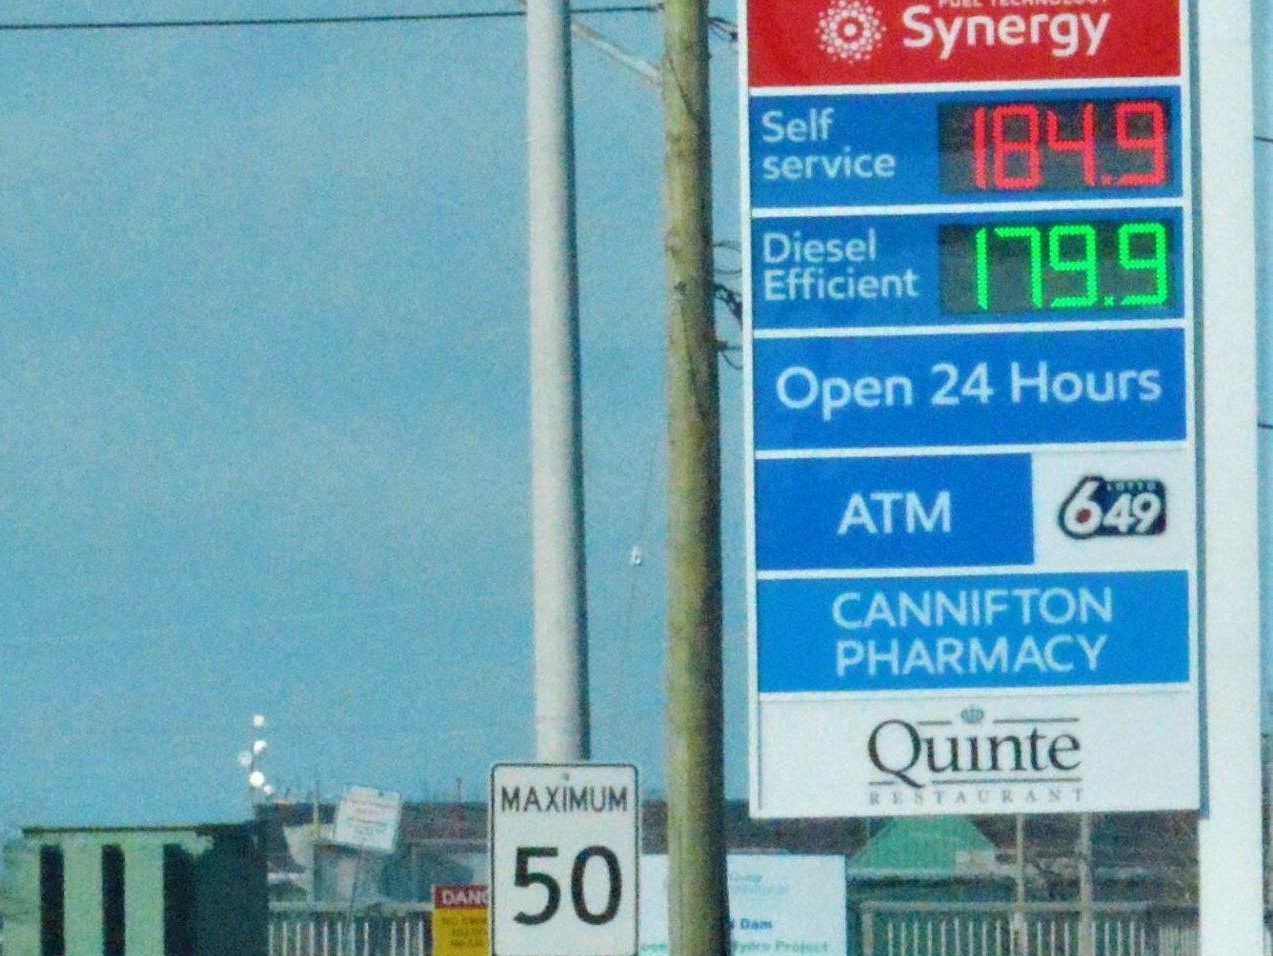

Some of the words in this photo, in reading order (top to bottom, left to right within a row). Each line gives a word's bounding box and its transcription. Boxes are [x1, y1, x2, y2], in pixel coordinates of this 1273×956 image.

[901, 4, 1112, 60] Synergy
[762, 107, 835, 143] Self
[973, 101, 1167, 190] 184.9
[762, 145, 896, 180] service
[763, 228, 876, 263] Diesel
[976, 222, 1169, 310] 179.9
[764, 266, 920, 301] Efficient
[776, 366, 913, 420] Open
[930, 362, 994, 405] 24
[1010, 361, 1163, 402] Hours
[837, 491, 952, 535] ATM
[832, 586, 1113, 629] CANNIFTON
[836, 635, 1108, 677] PHARMACY
[868, 719, 1082, 789] Quinte
[501, 785, 627, 813] MAXIMUM
[869, 788, 1084, 805] RESTAURANT
[442, 889, 489, 906] DANG
[513, 845, 623, 926] 50
[740, 917, 773, 930] Dam
